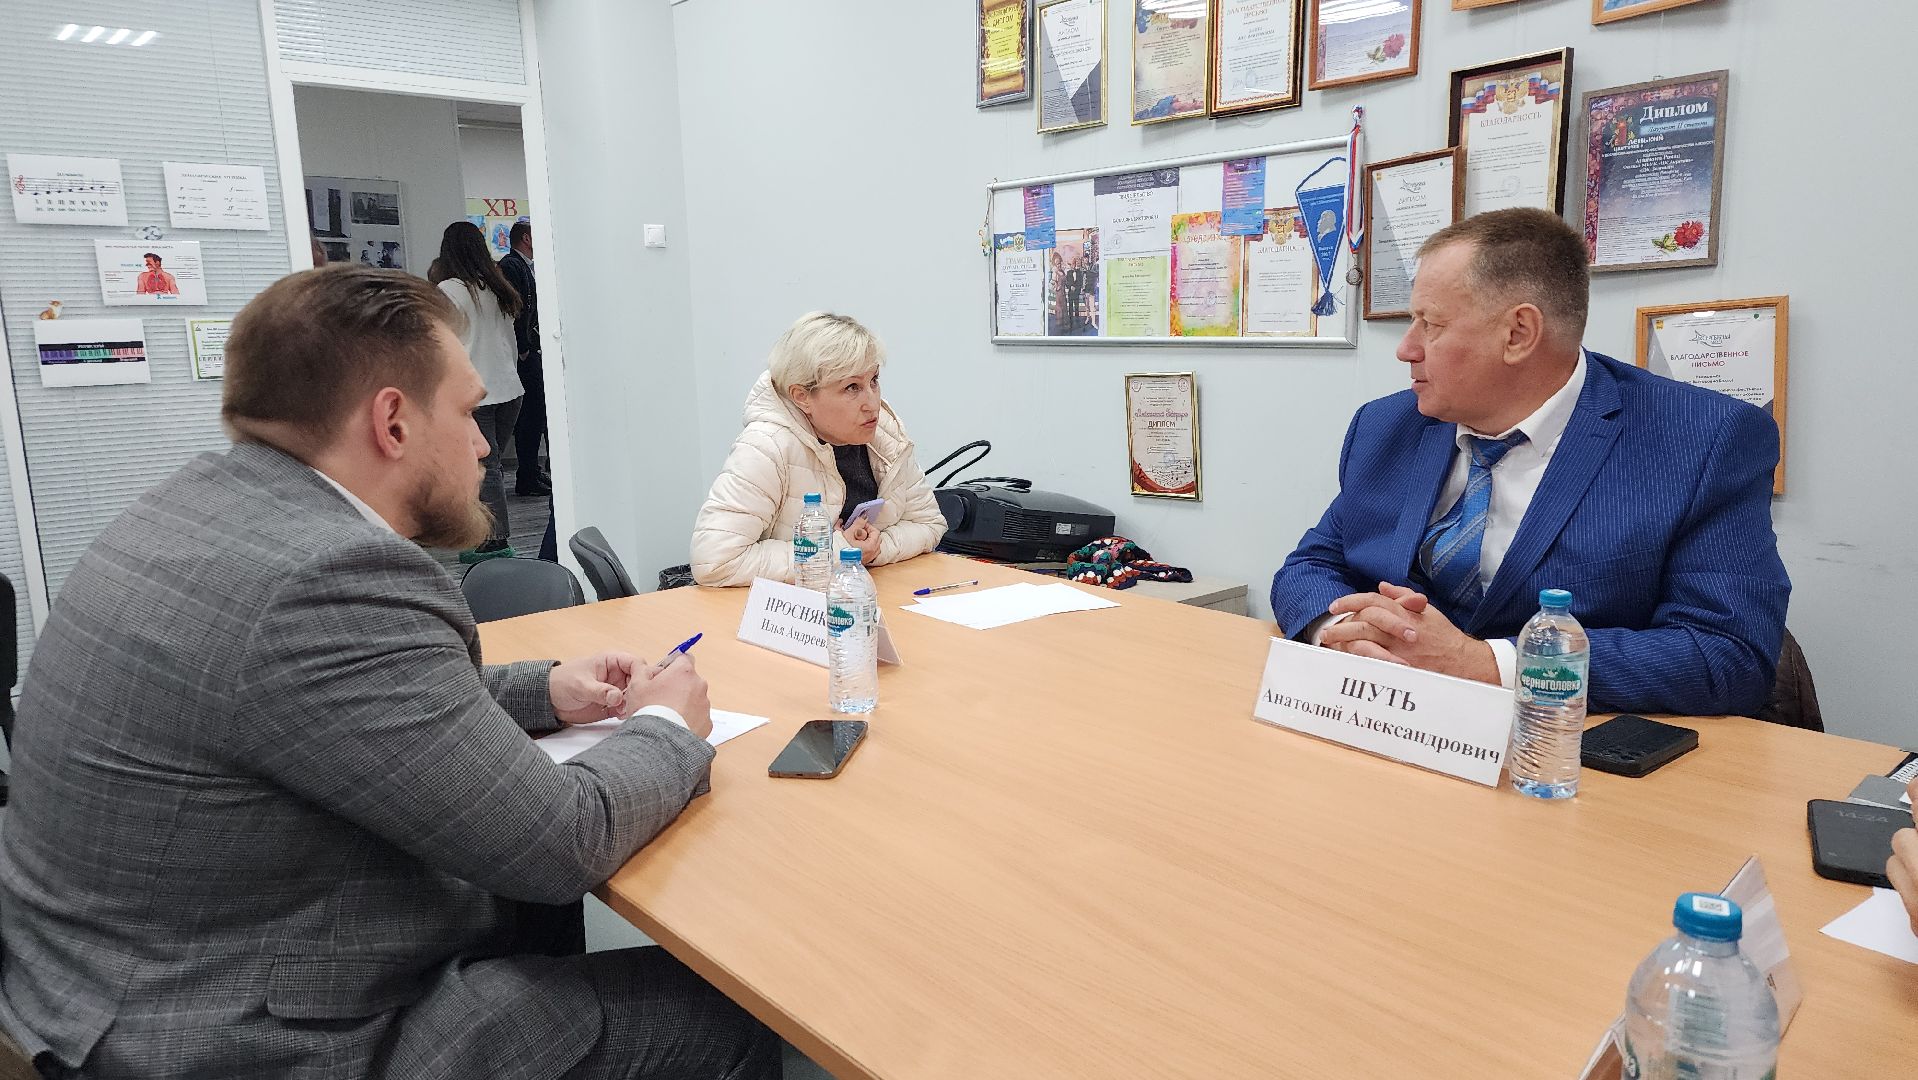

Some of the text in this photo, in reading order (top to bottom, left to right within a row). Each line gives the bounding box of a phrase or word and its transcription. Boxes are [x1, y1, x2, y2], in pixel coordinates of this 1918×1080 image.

[1480, 111, 1542, 128] БЛАГОДАРНОСТЬ
[1639, 101, 1709, 124] Диплом
[482, 198, 518, 217] ХВ
[1670, 351, 1749, 361] БЛАГОДАРСТВЕННОЕ
[1691, 360, 1726, 368] ПИСЬМО
[766, 597, 827, 627] ПРОСНЯК
[760, 618, 829, 649] Илья Андреев
[1340, 676, 1417, 713] ШУТЬ
[1263, 687, 1501, 764] Анатолий Александрович
